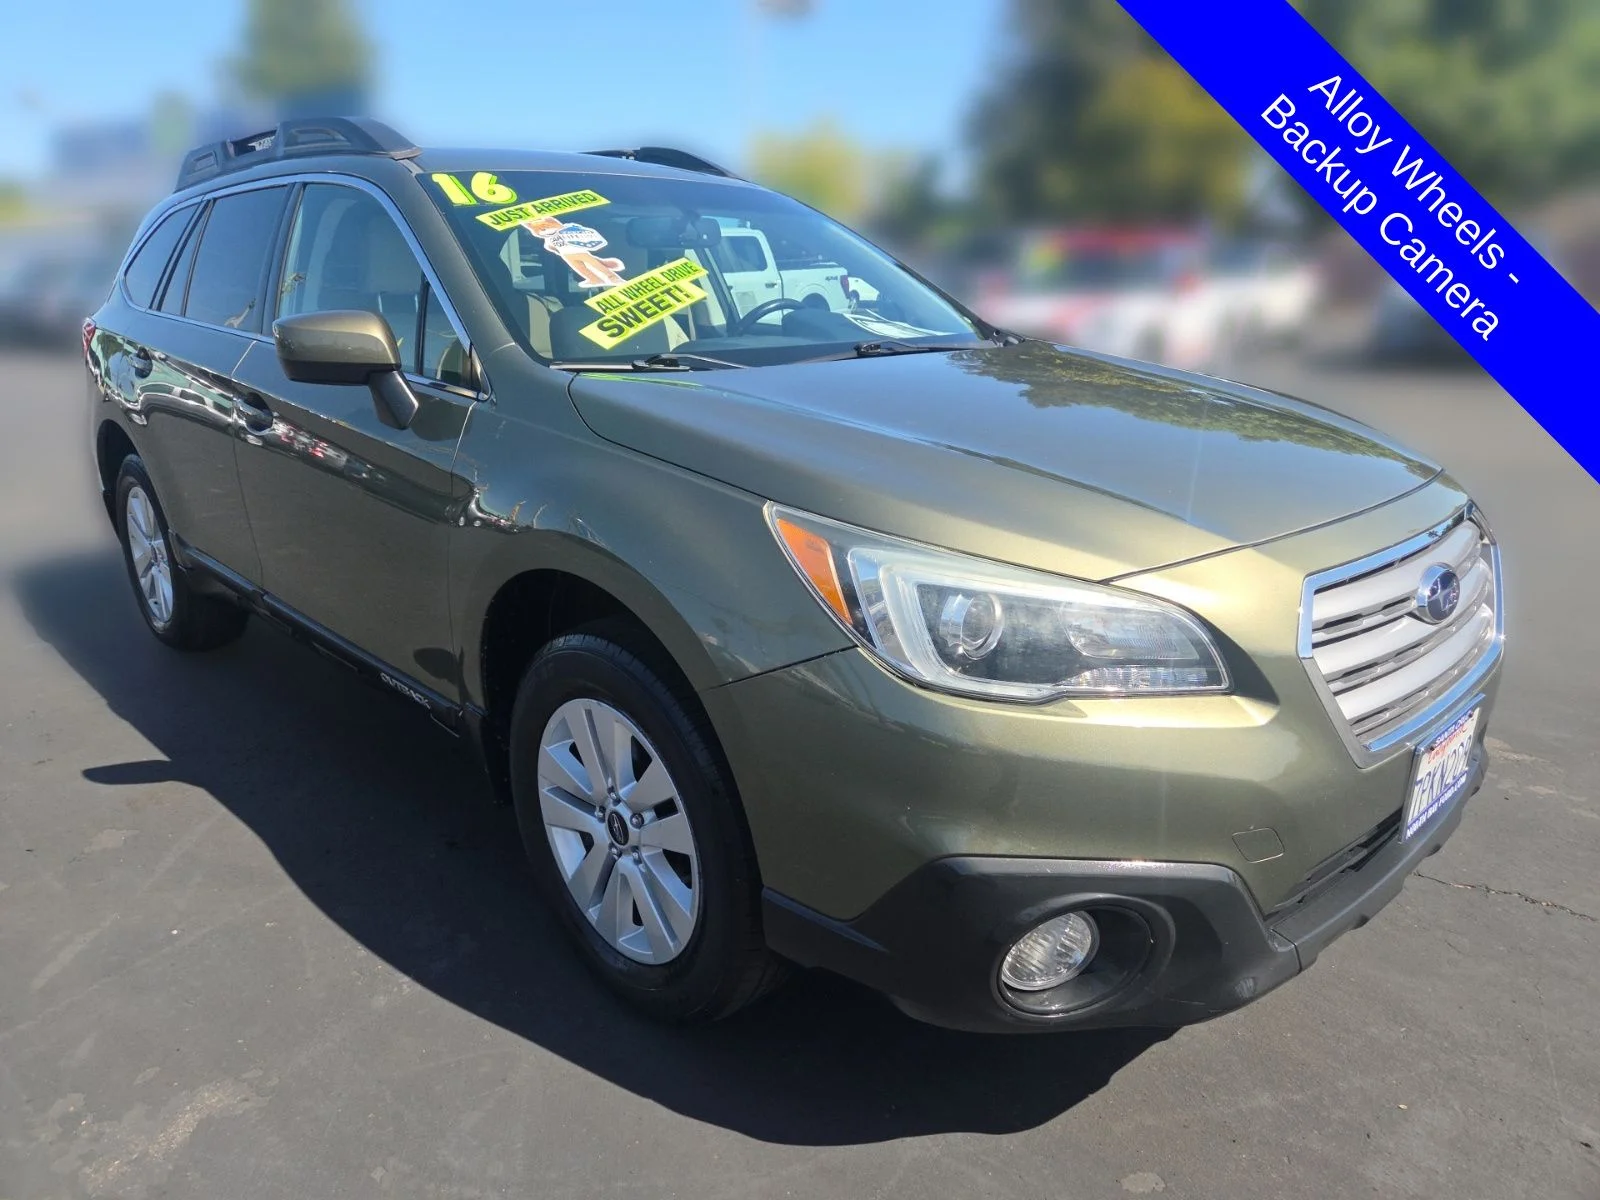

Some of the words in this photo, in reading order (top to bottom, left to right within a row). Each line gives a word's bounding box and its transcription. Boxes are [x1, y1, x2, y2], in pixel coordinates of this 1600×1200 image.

[431, 172, 517, 205] 16
[487, 207, 530, 226] JUST
[530, 191, 597, 215] ARRIVED
[595, 293, 623, 315] ALL
[617, 276, 664, 304] WHEEL
[661, 259, 701, 284] DRIVE
[597, 285, 692, 339] SWEET!
